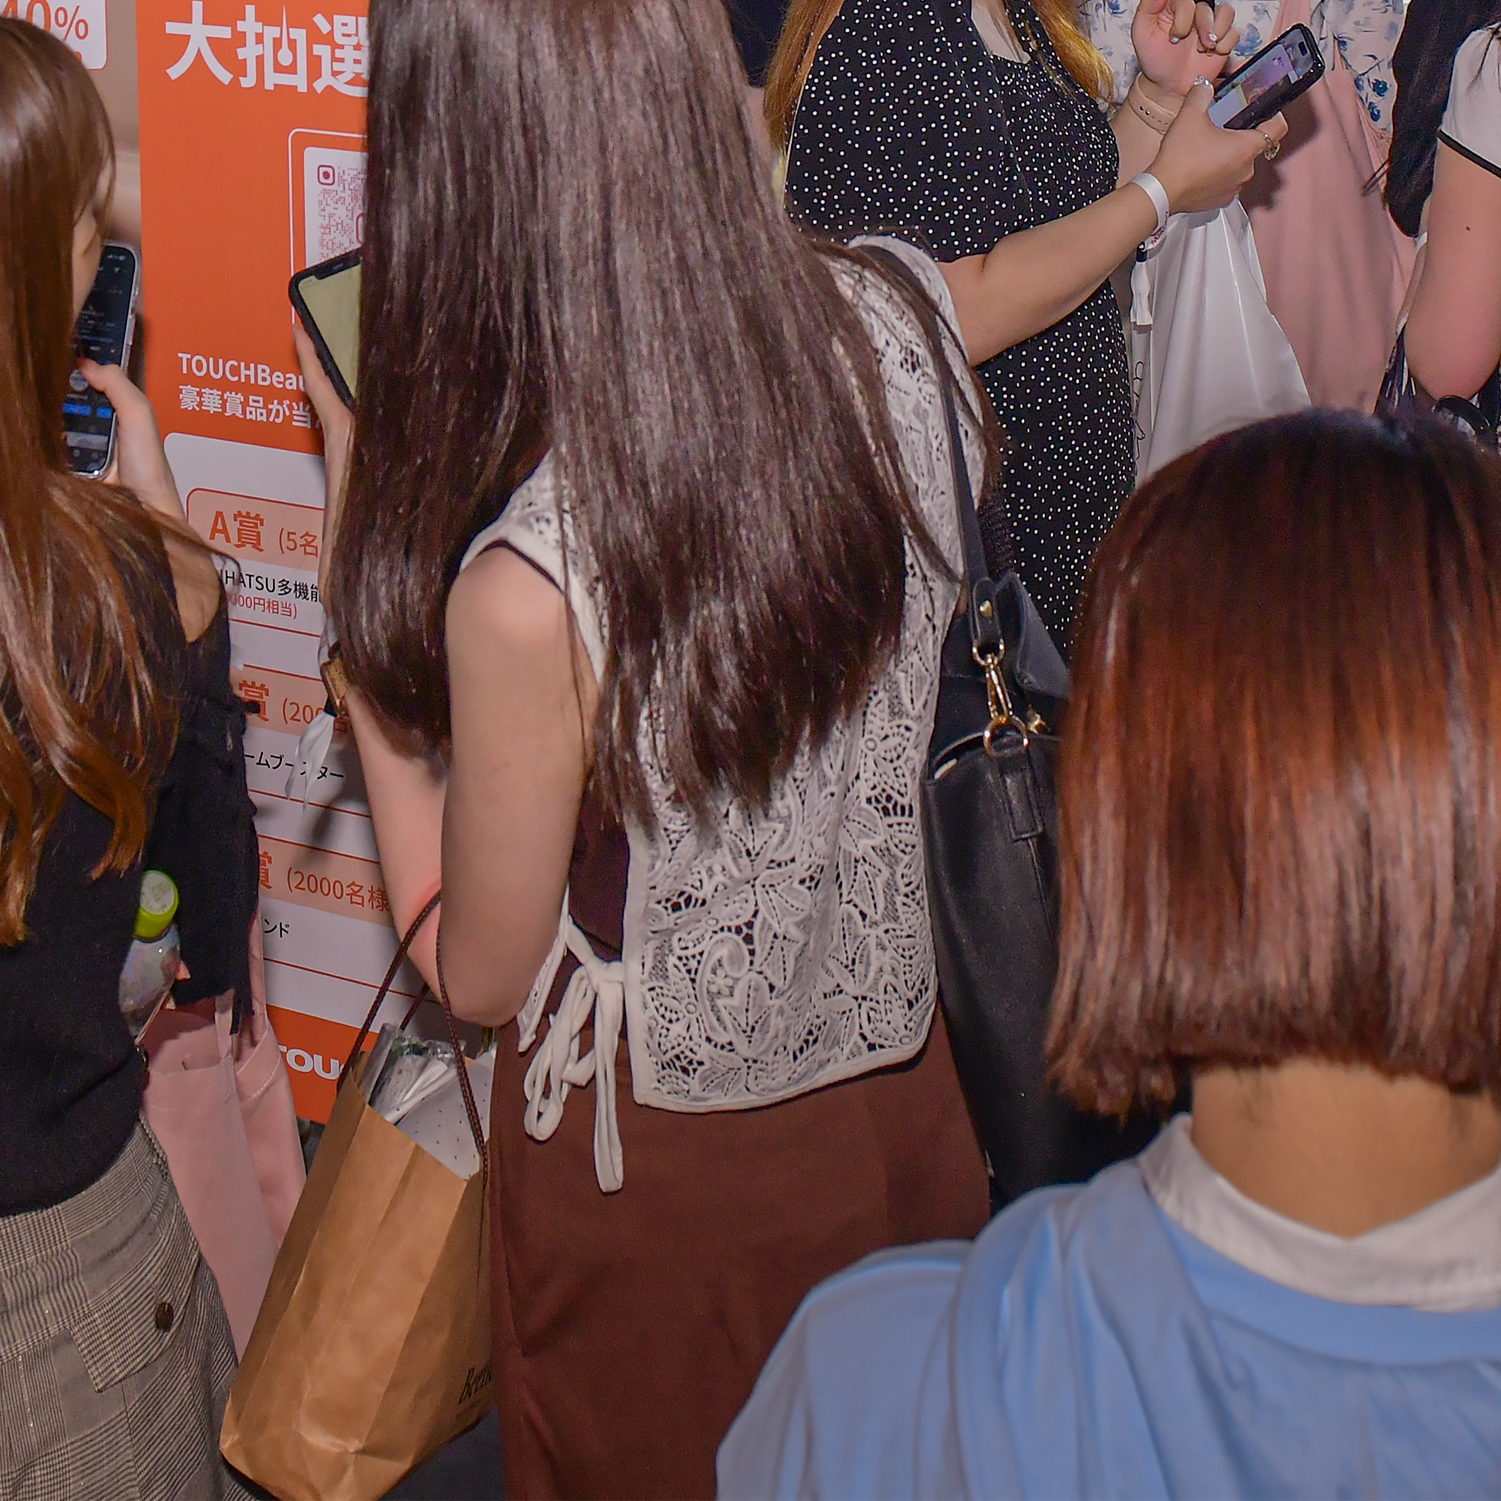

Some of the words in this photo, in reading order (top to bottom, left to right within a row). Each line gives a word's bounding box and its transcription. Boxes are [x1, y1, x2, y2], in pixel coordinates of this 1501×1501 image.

[179, 384, 321, 430] 豪華賞品が当
